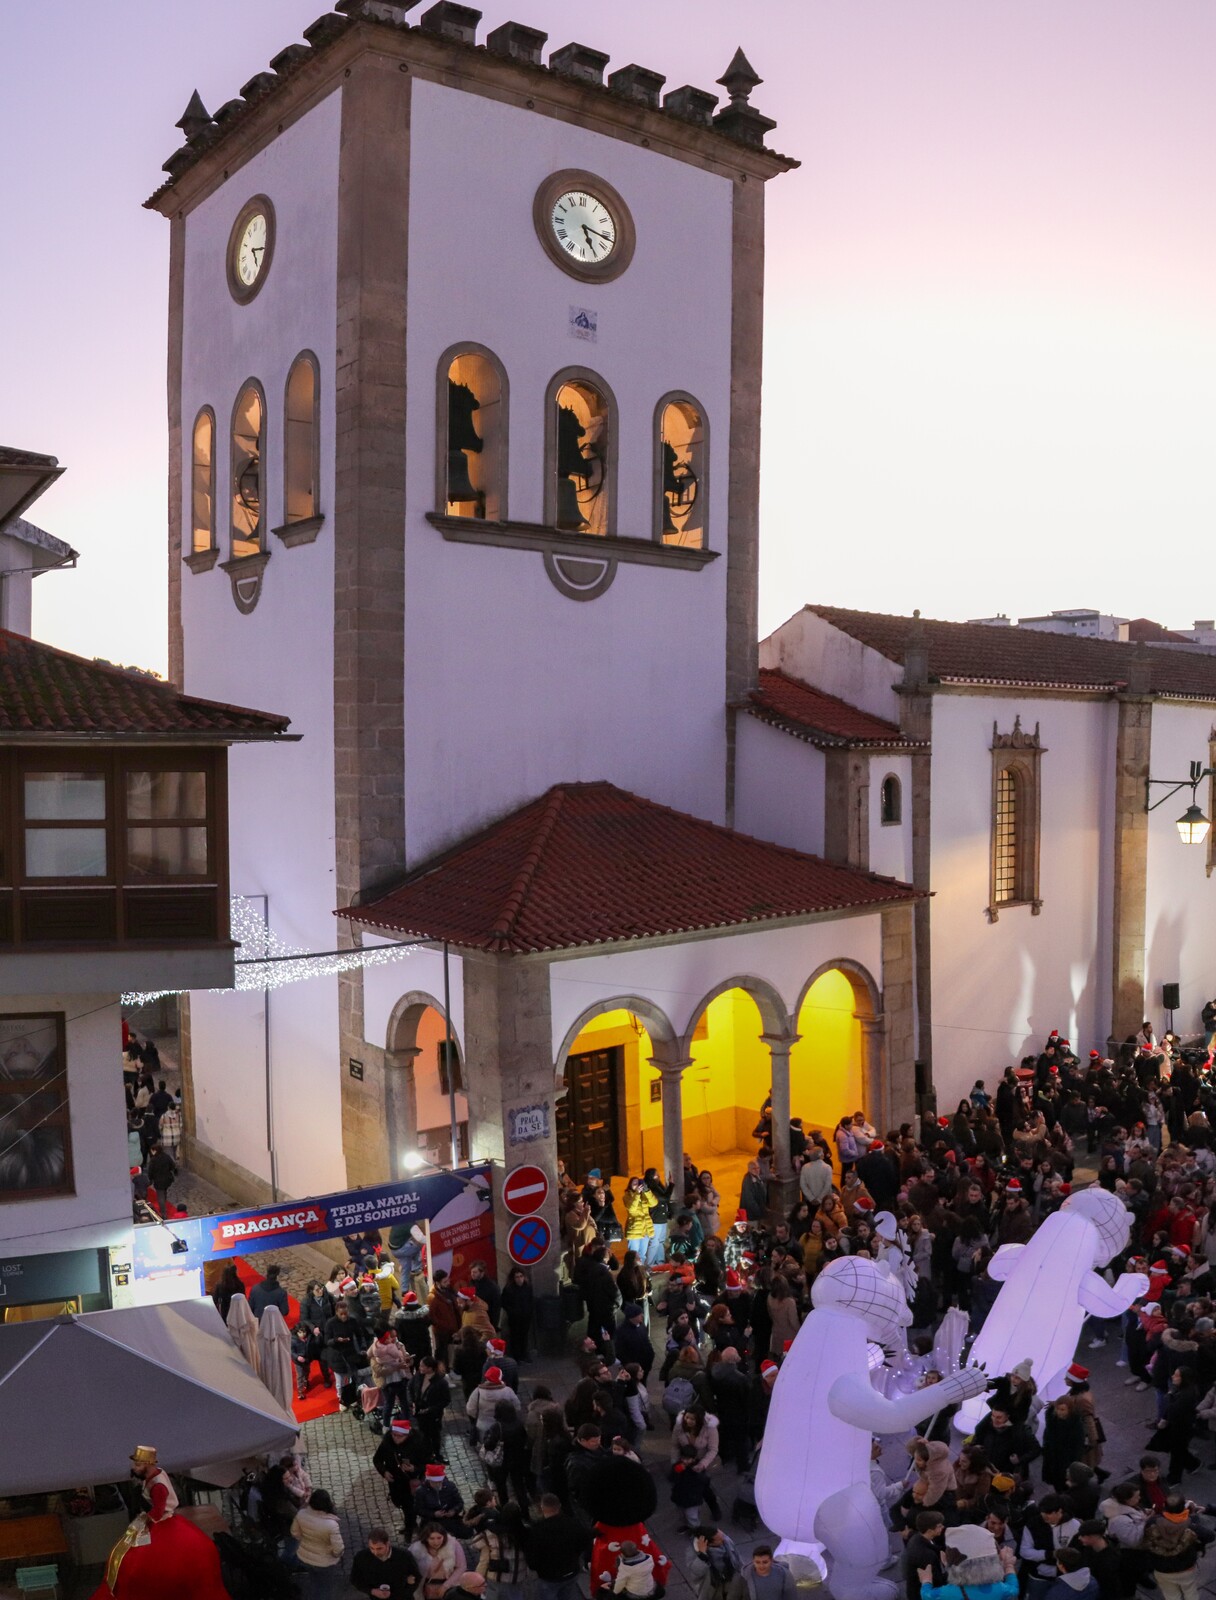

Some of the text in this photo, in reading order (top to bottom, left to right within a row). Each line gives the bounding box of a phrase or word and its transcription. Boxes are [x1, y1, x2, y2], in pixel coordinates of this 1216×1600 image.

[579, 196, 587, 208] XII
[518, 1126, 528, 1134] DA
[330, 1191, 420, 1218] TERRA NATAL
[222, 1210, 319, 1238] BRAGANÇA
[334, 1203, 418, 1229] E DE SONHOS
[2, 1264, 21, 1272] LOST
